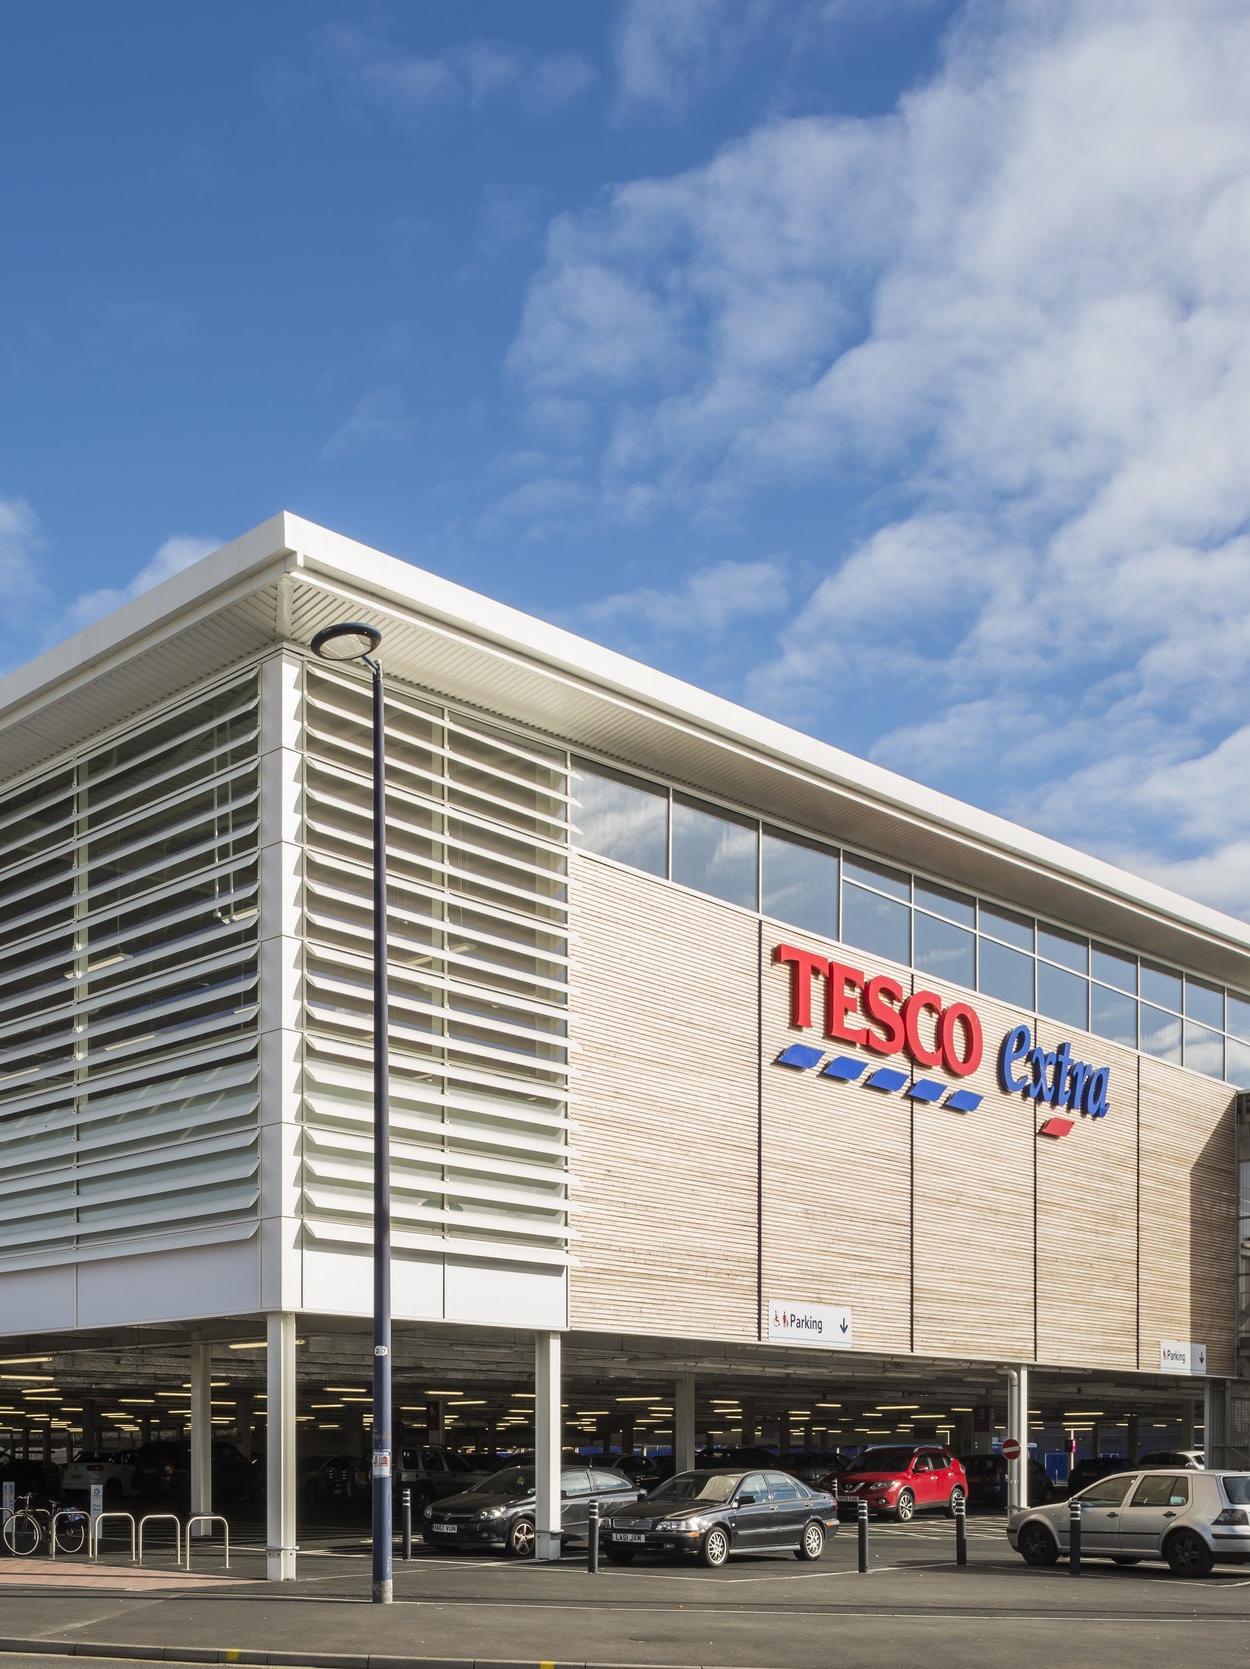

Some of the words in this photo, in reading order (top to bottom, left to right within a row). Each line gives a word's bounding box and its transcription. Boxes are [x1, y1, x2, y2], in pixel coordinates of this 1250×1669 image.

[775, 943, 983, 1076] TESCO
[1001, 1025, 1110, 1117] extra
[790, 1314, 823, 1333] Parking
[1166, 1349, 1186, 1364] Parking
